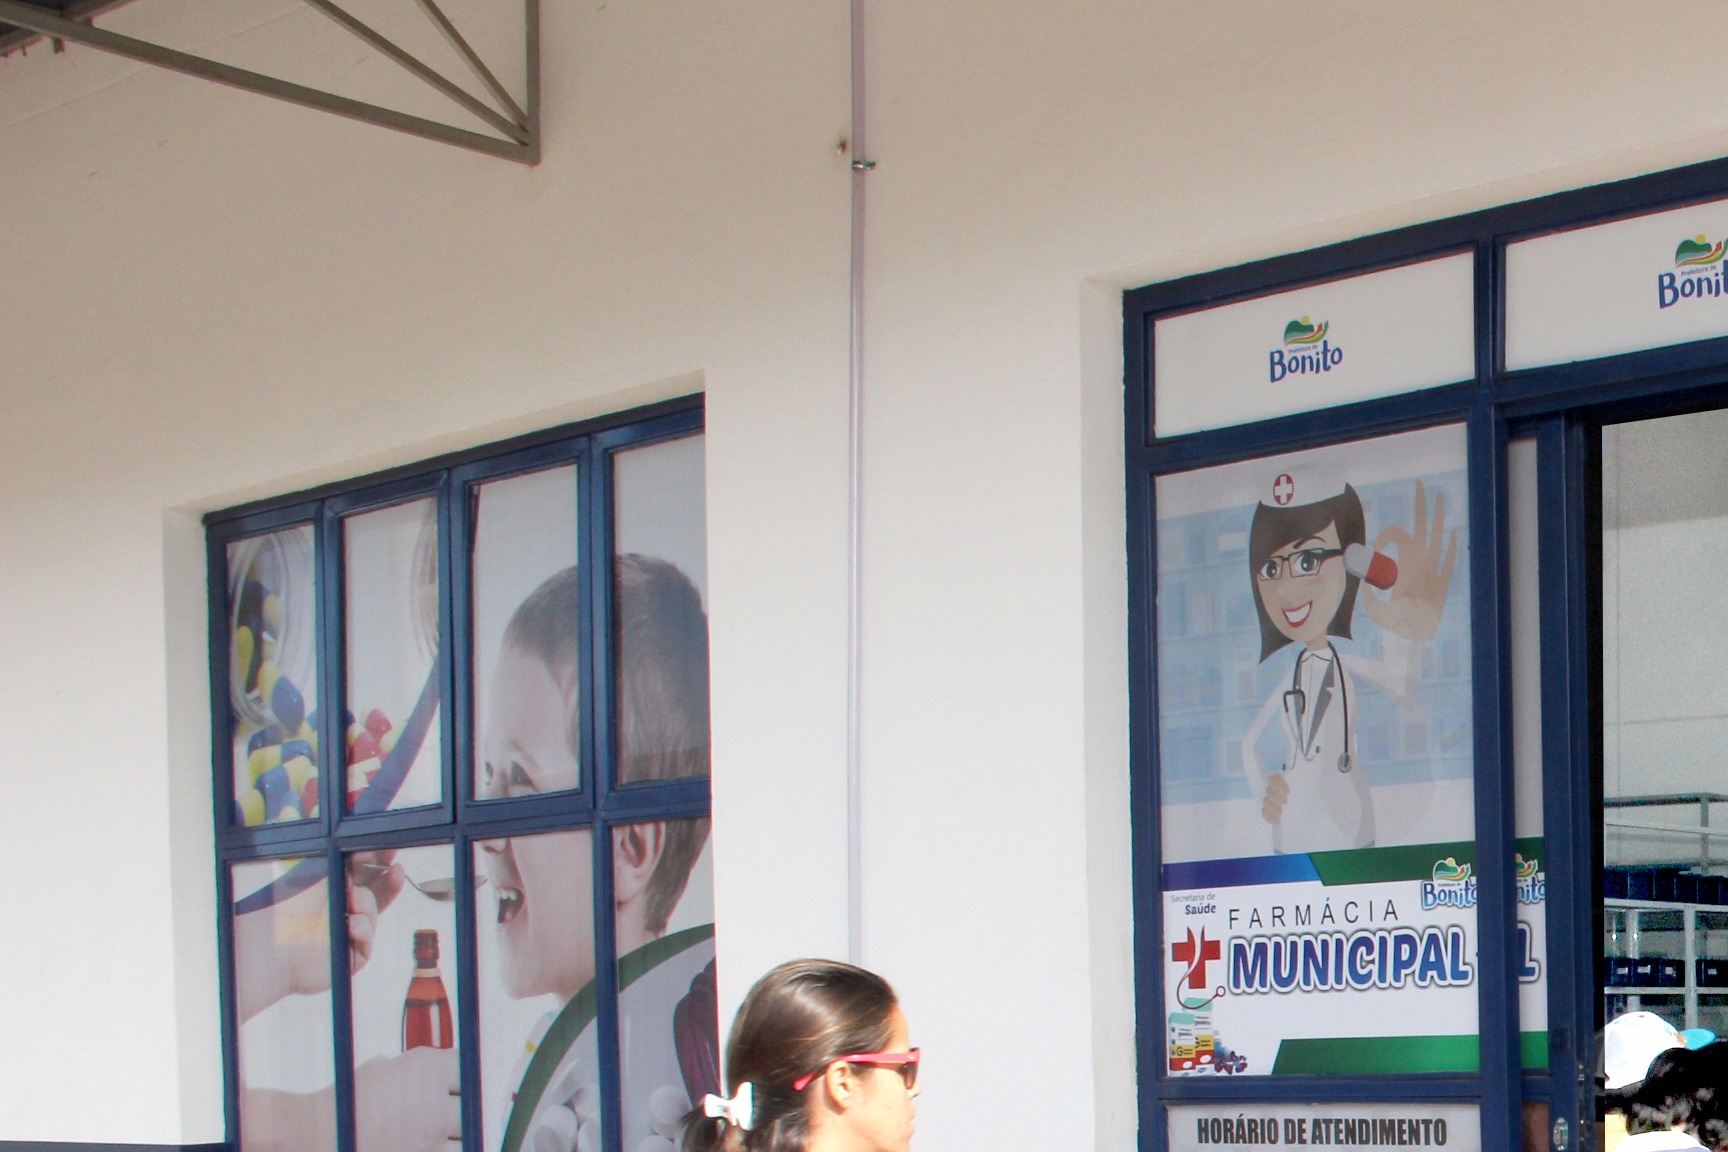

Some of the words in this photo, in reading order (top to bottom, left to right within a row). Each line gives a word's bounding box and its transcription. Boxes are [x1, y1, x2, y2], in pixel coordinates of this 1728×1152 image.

[1269, 340, 1344, 383] Bonito
[1171, 893, 1205, 903] Secretaria
[1206, 892, 1216, 901] de
[1185, 902, 1217, 915] Saúde
[1228, 897, 1399, 930] FARMÁCIA
[1230, 929, 1473, 992] MUNICIPAL
[1197, 1113, 1279, 1145] HORÁRIO
[1284, 1118, 1307, 1145] DE
[1311, 1118, 1447, 1146] ATENDIMENTO
